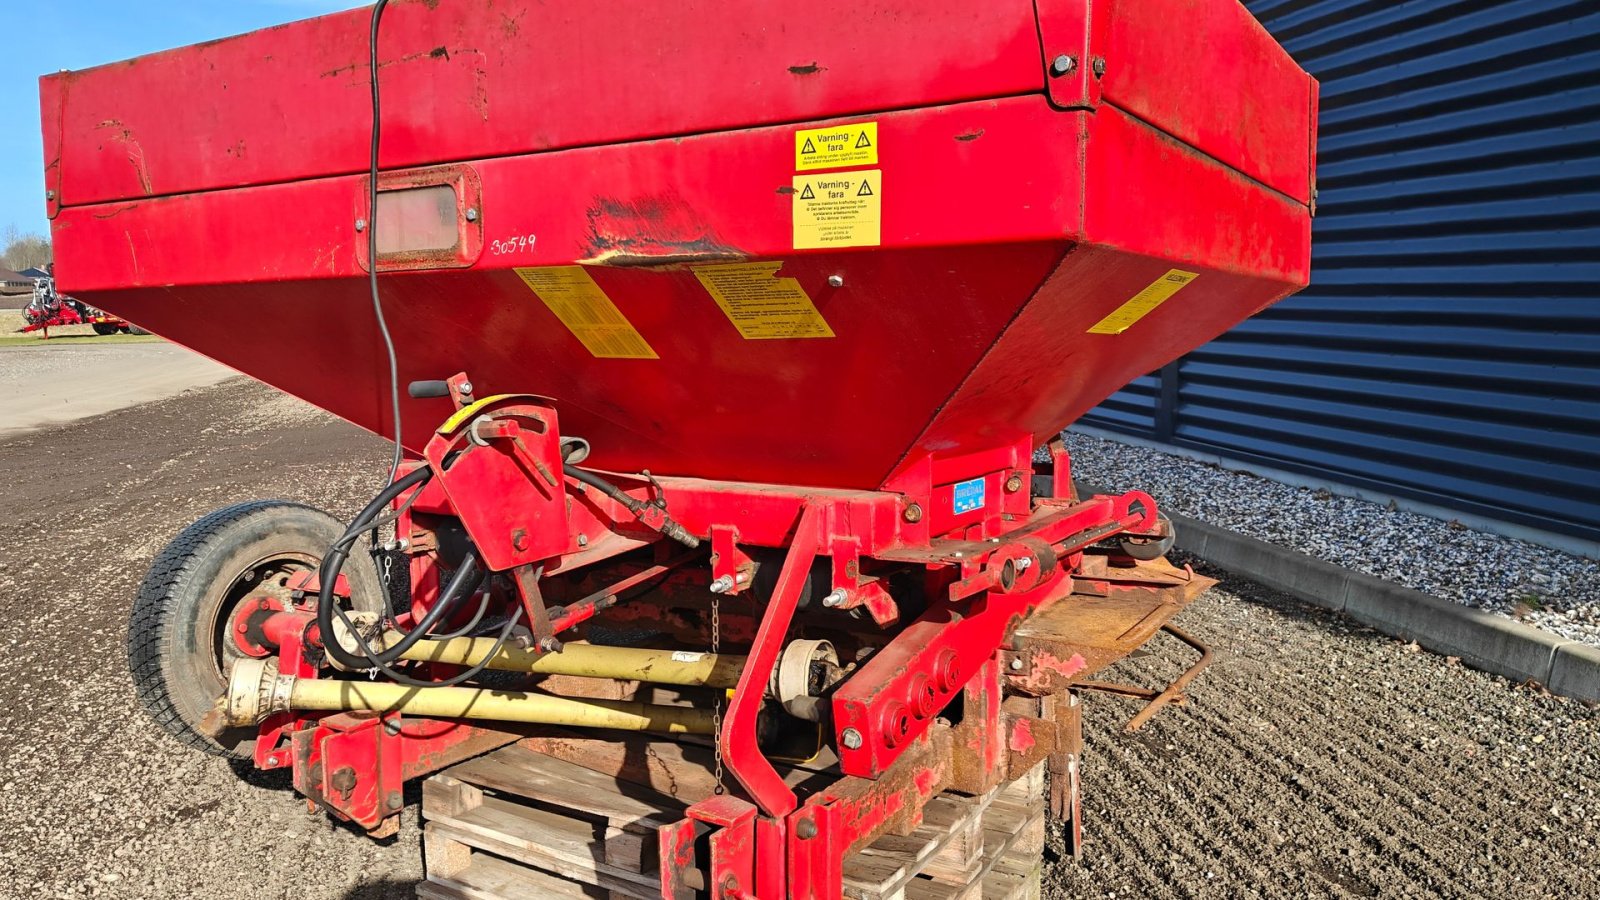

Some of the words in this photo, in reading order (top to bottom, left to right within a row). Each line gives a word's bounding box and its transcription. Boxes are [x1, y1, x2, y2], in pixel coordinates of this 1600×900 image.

[817, 132, 849, 142] Varning
[817, 181, 850, 189] Varning
[828, 191, 844, 199] fara
[492, 234, 536, 255] 30549
